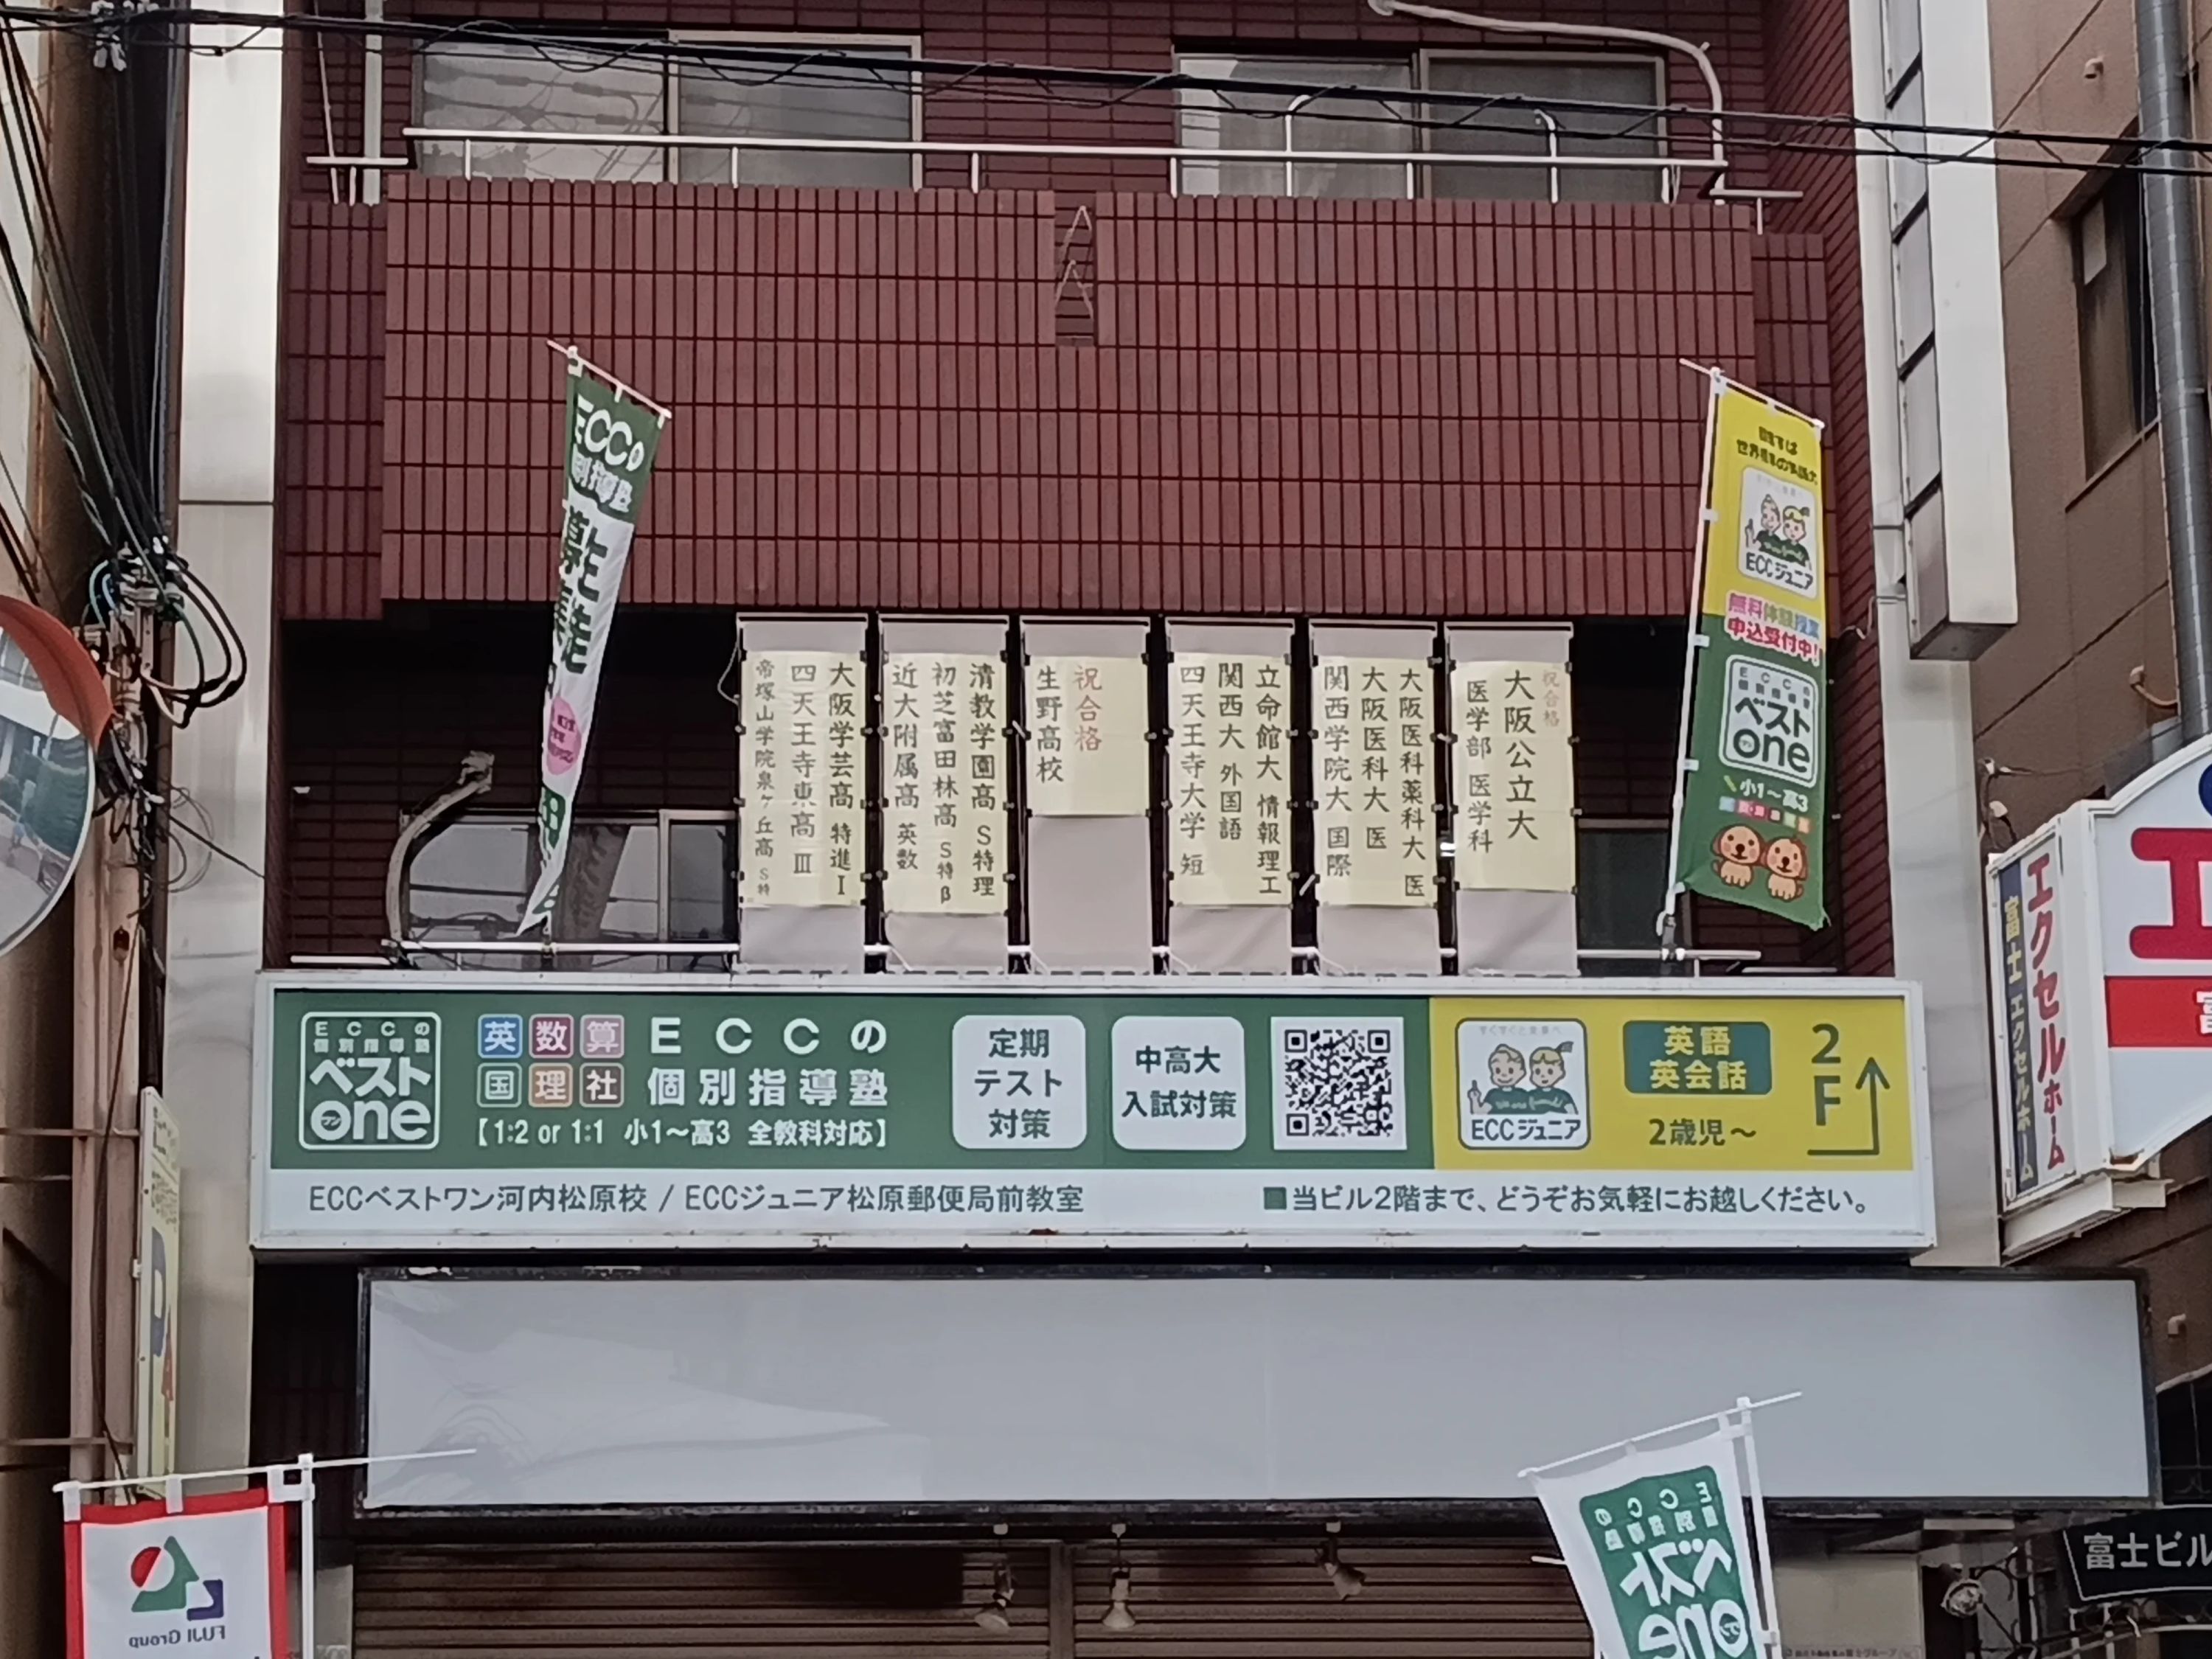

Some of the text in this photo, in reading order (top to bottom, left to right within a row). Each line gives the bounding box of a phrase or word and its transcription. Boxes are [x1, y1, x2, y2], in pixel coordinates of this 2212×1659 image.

[1745, 552, 1814, 590] ECCジュニア
[1036, 665, 1064, 784] 生野高校
[1074, 666, 1103, 751] 祝合格
[1735, 697, 1811, 738] ベスト
[828, 661, 855, 810] 大阪学芸高
[931, 662, 959, 828] 初芝富田林高
[1218, 662, 1245, 841] 関西大 外国語
[1504, 669, 1538, 841] 大阪公立大
[1733, 728, 1811, 773] one
[893, 662, 920, 870] 近大附属高 英数
[1180, 666, 1207, 876] 四天王寺大学 短
[1324, 665, 1353, 877] 関西学院大 国際
[1361, 666, 1390, 849] 大阪医科大 医
[1466, 680, 1494, 854] 医学部 医学科
[969, 661, 997, 897] 清教学園高 S特理
[1256, 664, 1283, 894] 立命館大 情報理工
[1399, 667, 1426, 897] 大阪医科薬科大 医
[2028, 852, 2065, 1170] エクセルホーム
[651, 1017, 887, 1055] ECCの
[988, 1027, 1049, 1058] 定期
[1663, 1024, 1731, 1056] 英語
[309, 1056, 431, 1098] ベスト
[1135, 1045, 1221, 1074] 中高大
[1649, 1059, 1747, 1090] 英会話
[647, 1067, 888, 1107] 個別指導塾
[974, 1068, 1062, 1097] テスト
[310, 1100, 431, 1141] one
[988, 1108, 1051, 1139] 対策
[1121, 1089, 1237, 1119] 入試対策
[538, 1124, 560, 1144] or
[571, 1119, 603, 1144] 1:1
[1471, 1118, 1581, 1141] ECCジュニア
[310, 1183, 647, 1213] ECCベストワン河内松原校
[685, 1183, 1084, 1213] ECCジュニア松原郵便局前教室
[2083, 1531, 2212, 1570] 富士ビル
